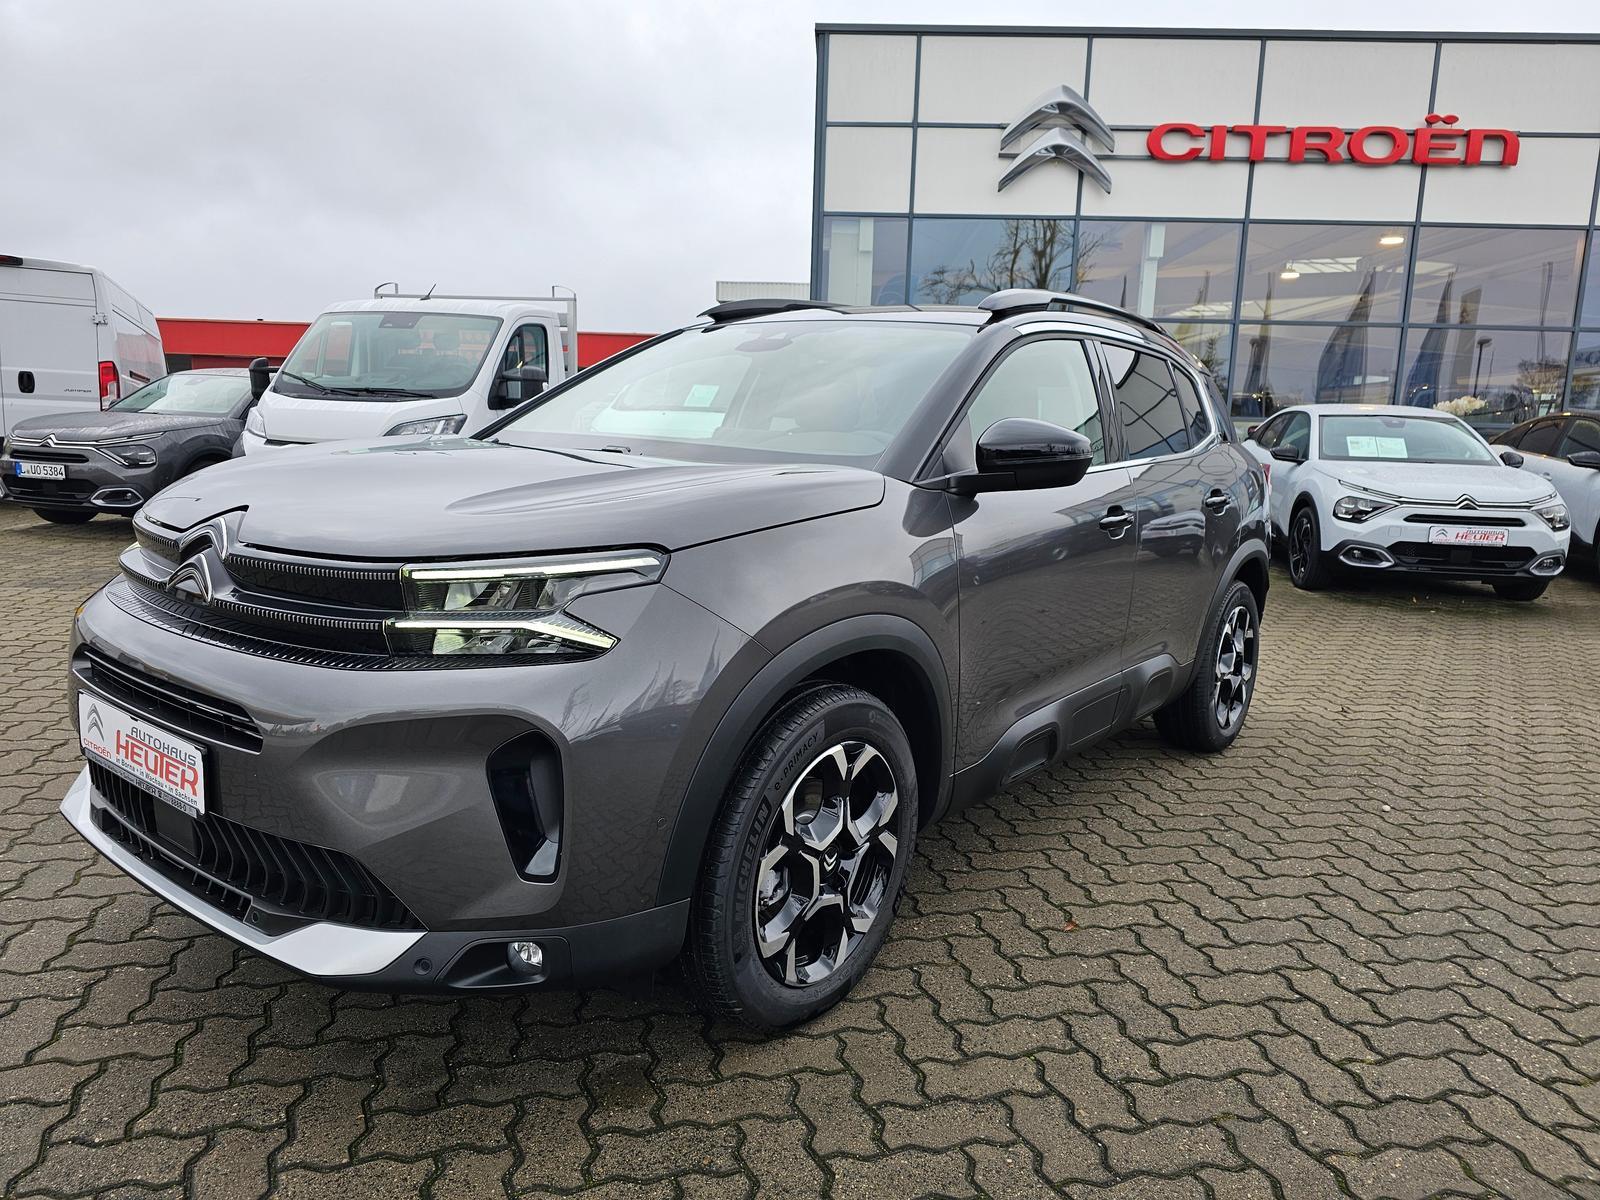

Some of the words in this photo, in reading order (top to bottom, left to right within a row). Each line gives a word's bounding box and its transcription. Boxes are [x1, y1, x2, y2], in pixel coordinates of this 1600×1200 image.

[1146, 113, 1521, 167] CITROËN
[30, 464, 42, 475] UO
[42, 465, 64, 476] 5384
[83, 737, 112, 760] CITROËN
[116, 729, 199, 797] HEUTER
[131, 726, 197, 766] AUTOHAUS
[174, 788, 198, 807] Sachsen
[735, 803, 771, 923] MICHELIN
